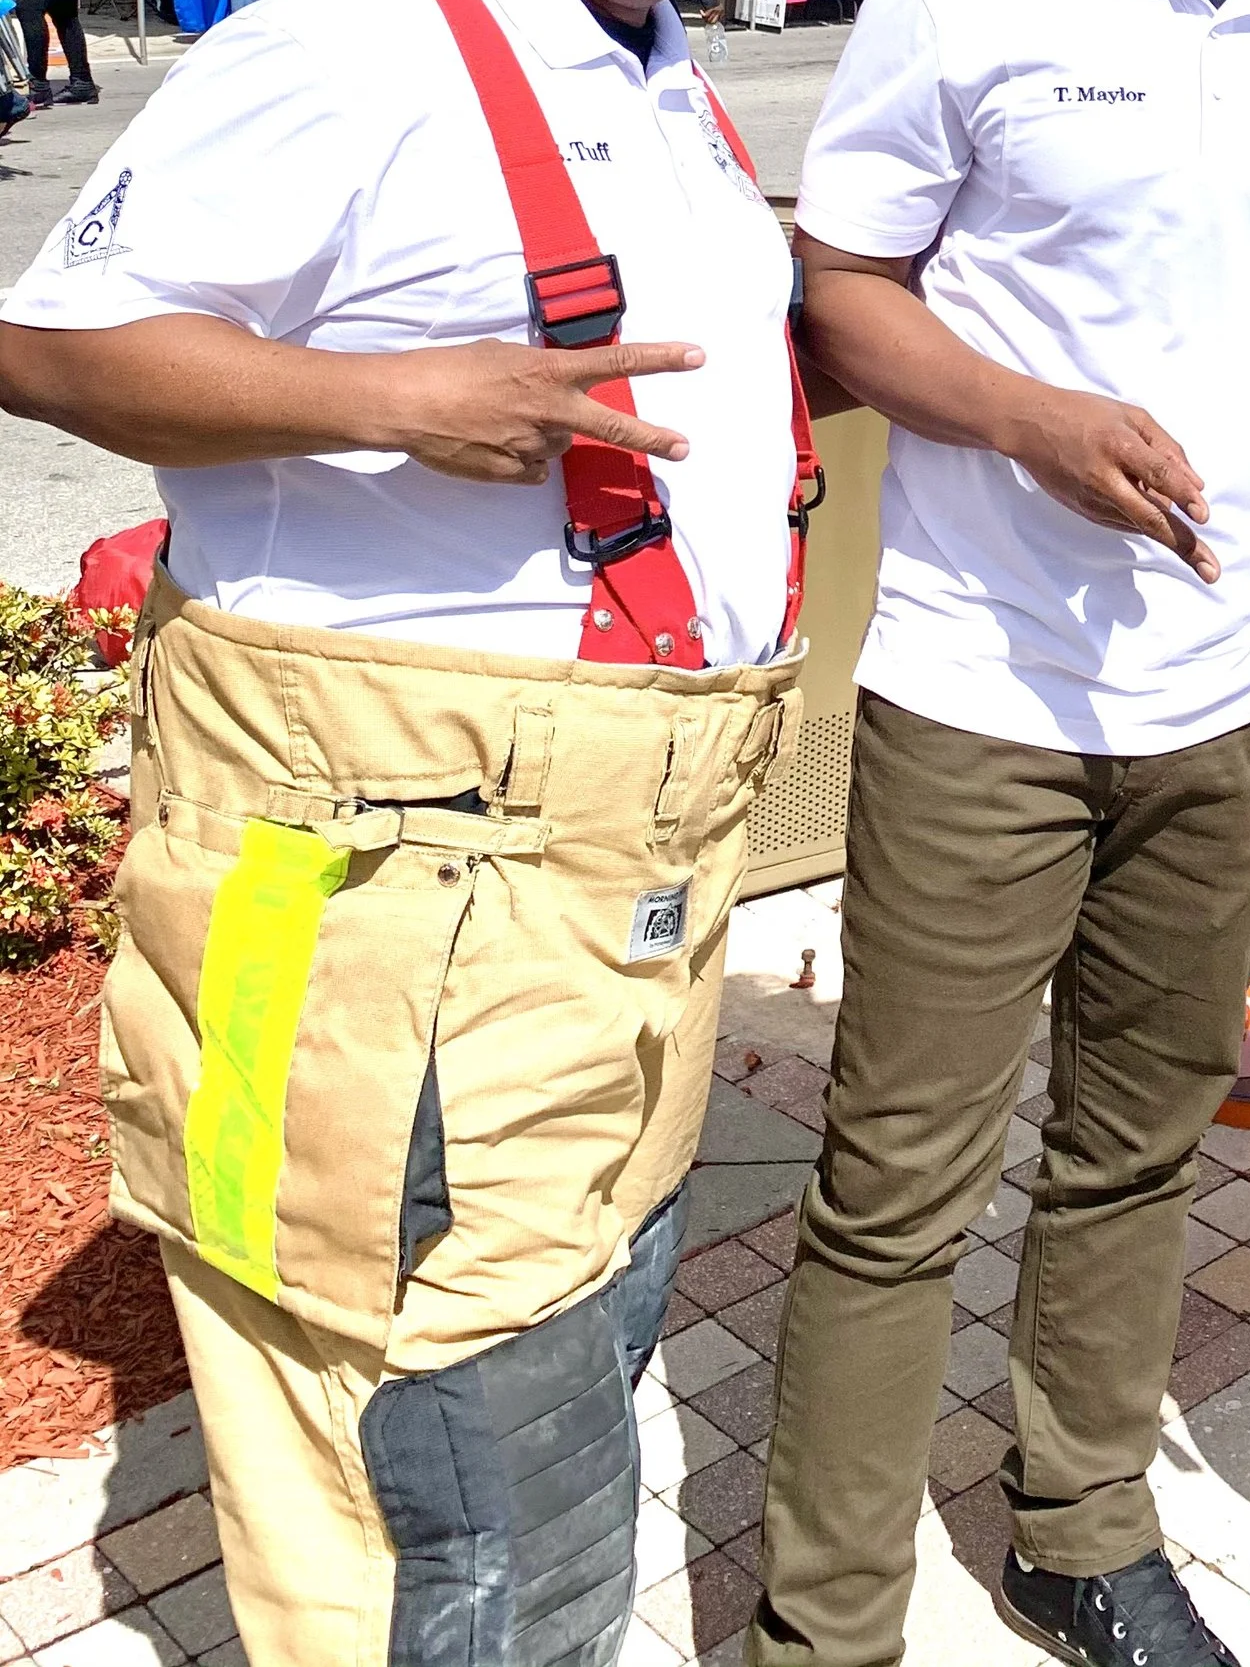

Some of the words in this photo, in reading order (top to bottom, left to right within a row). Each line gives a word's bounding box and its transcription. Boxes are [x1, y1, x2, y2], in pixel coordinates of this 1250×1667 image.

[1053, 86, 1073, 103] T.
[1076, 85, 1146, 105] Maylor
[569, 141, 612, 162] Tuff
[78, 220, 105, 246] C
